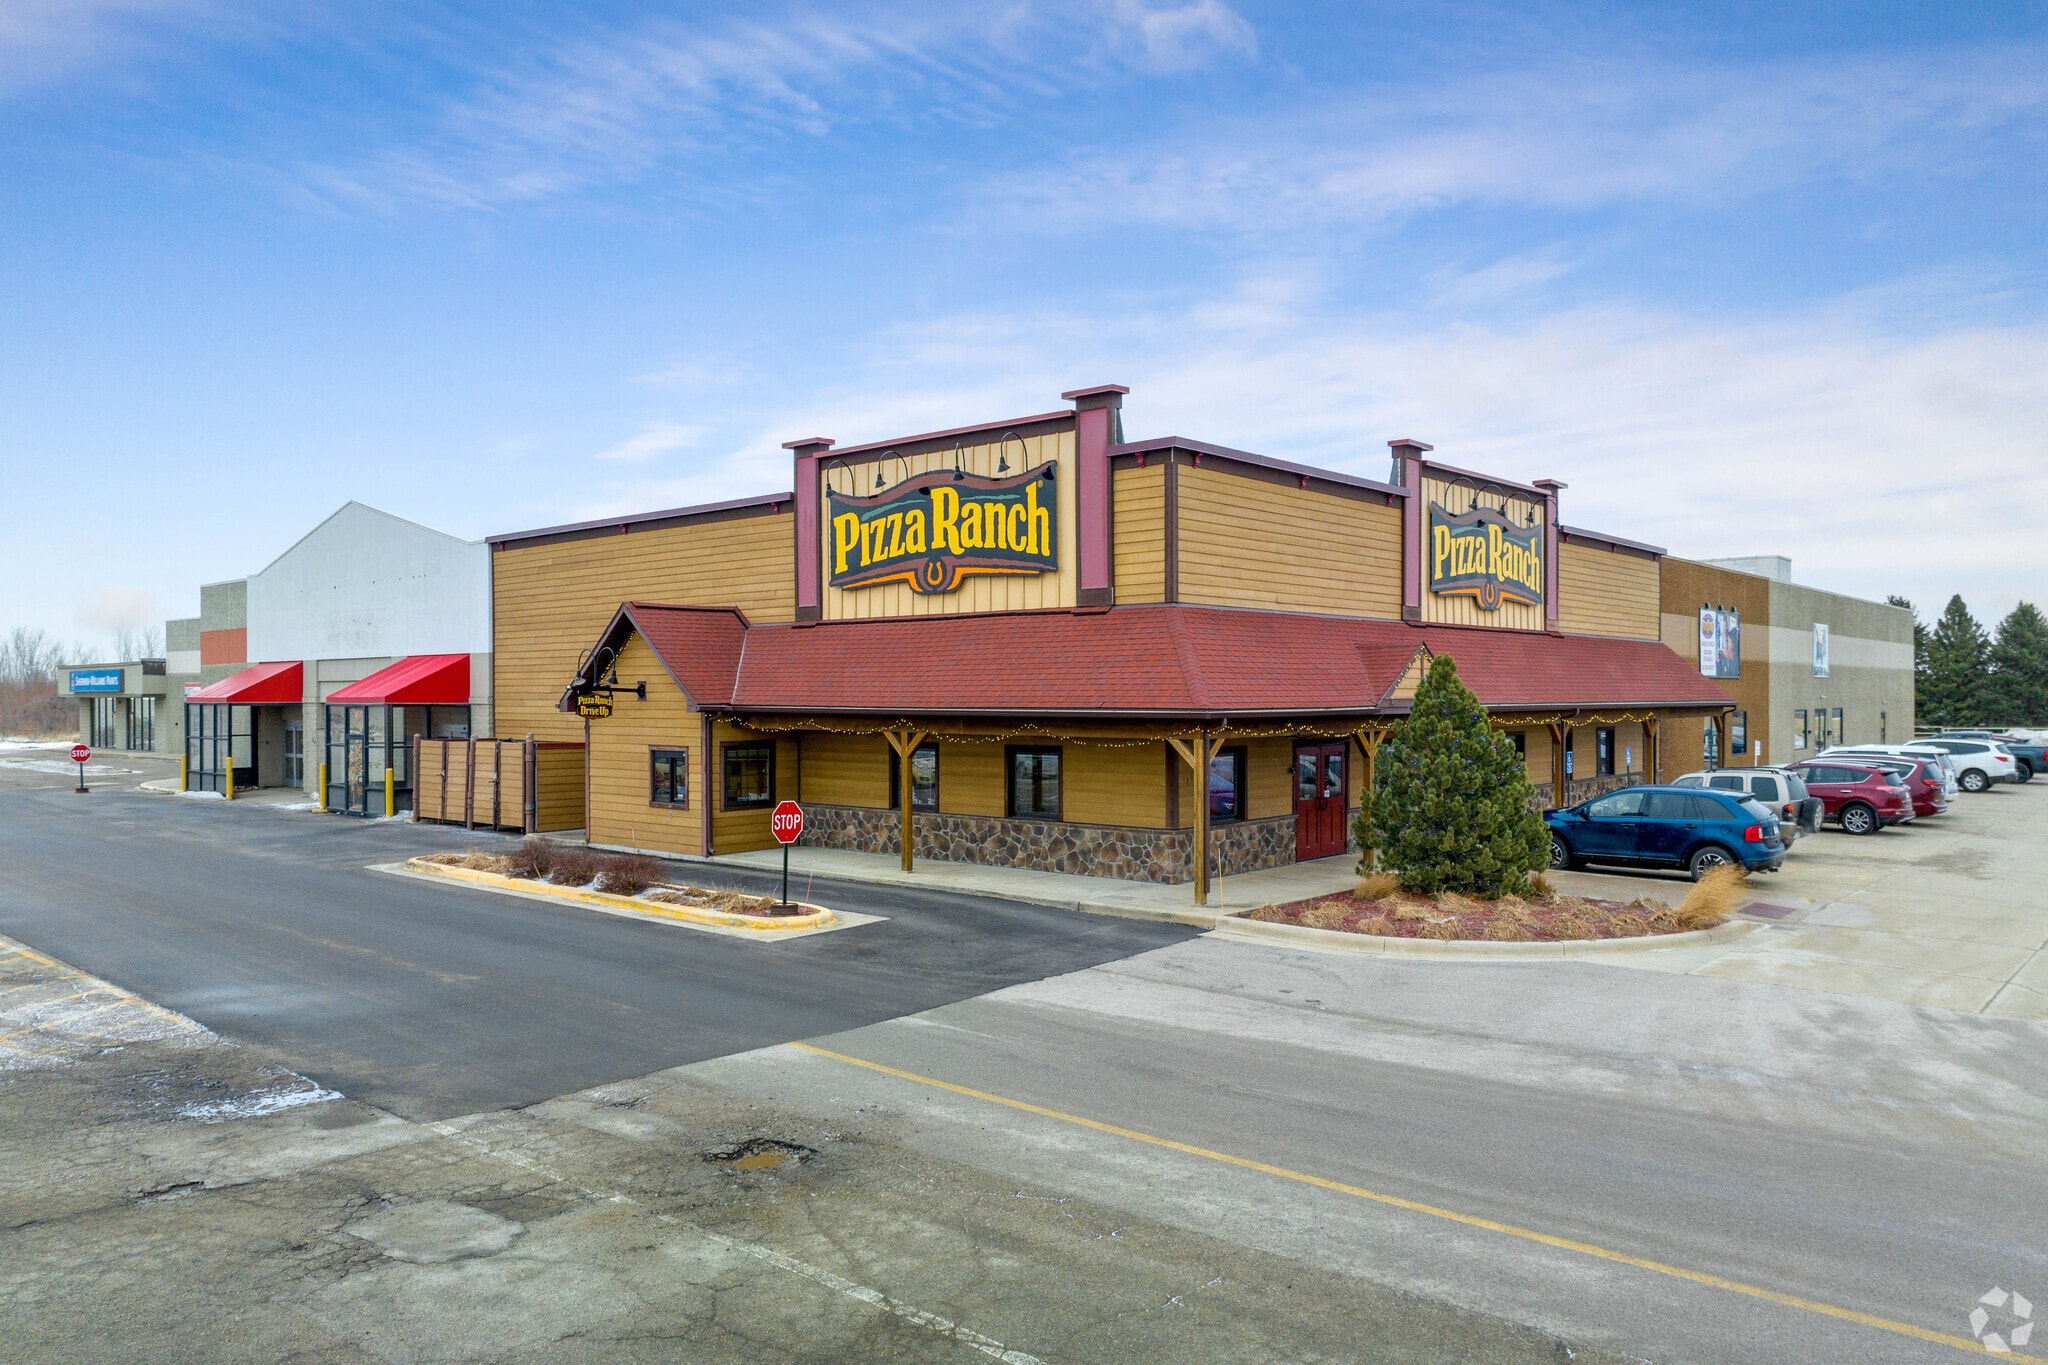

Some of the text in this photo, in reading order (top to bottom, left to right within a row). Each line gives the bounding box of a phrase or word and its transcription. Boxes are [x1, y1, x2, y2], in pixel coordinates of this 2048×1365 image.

[833, 481, 1051, 575] Pizza Ranch
[1433, 523, 1541, 594] Pizza Ranch
[578, 695, 613, 707] Pizza Ranch
[580, 705, 609, 717] Drive Up
[71, 750, 90, 758] STOP
[774, 813, 801, 830] STOP
